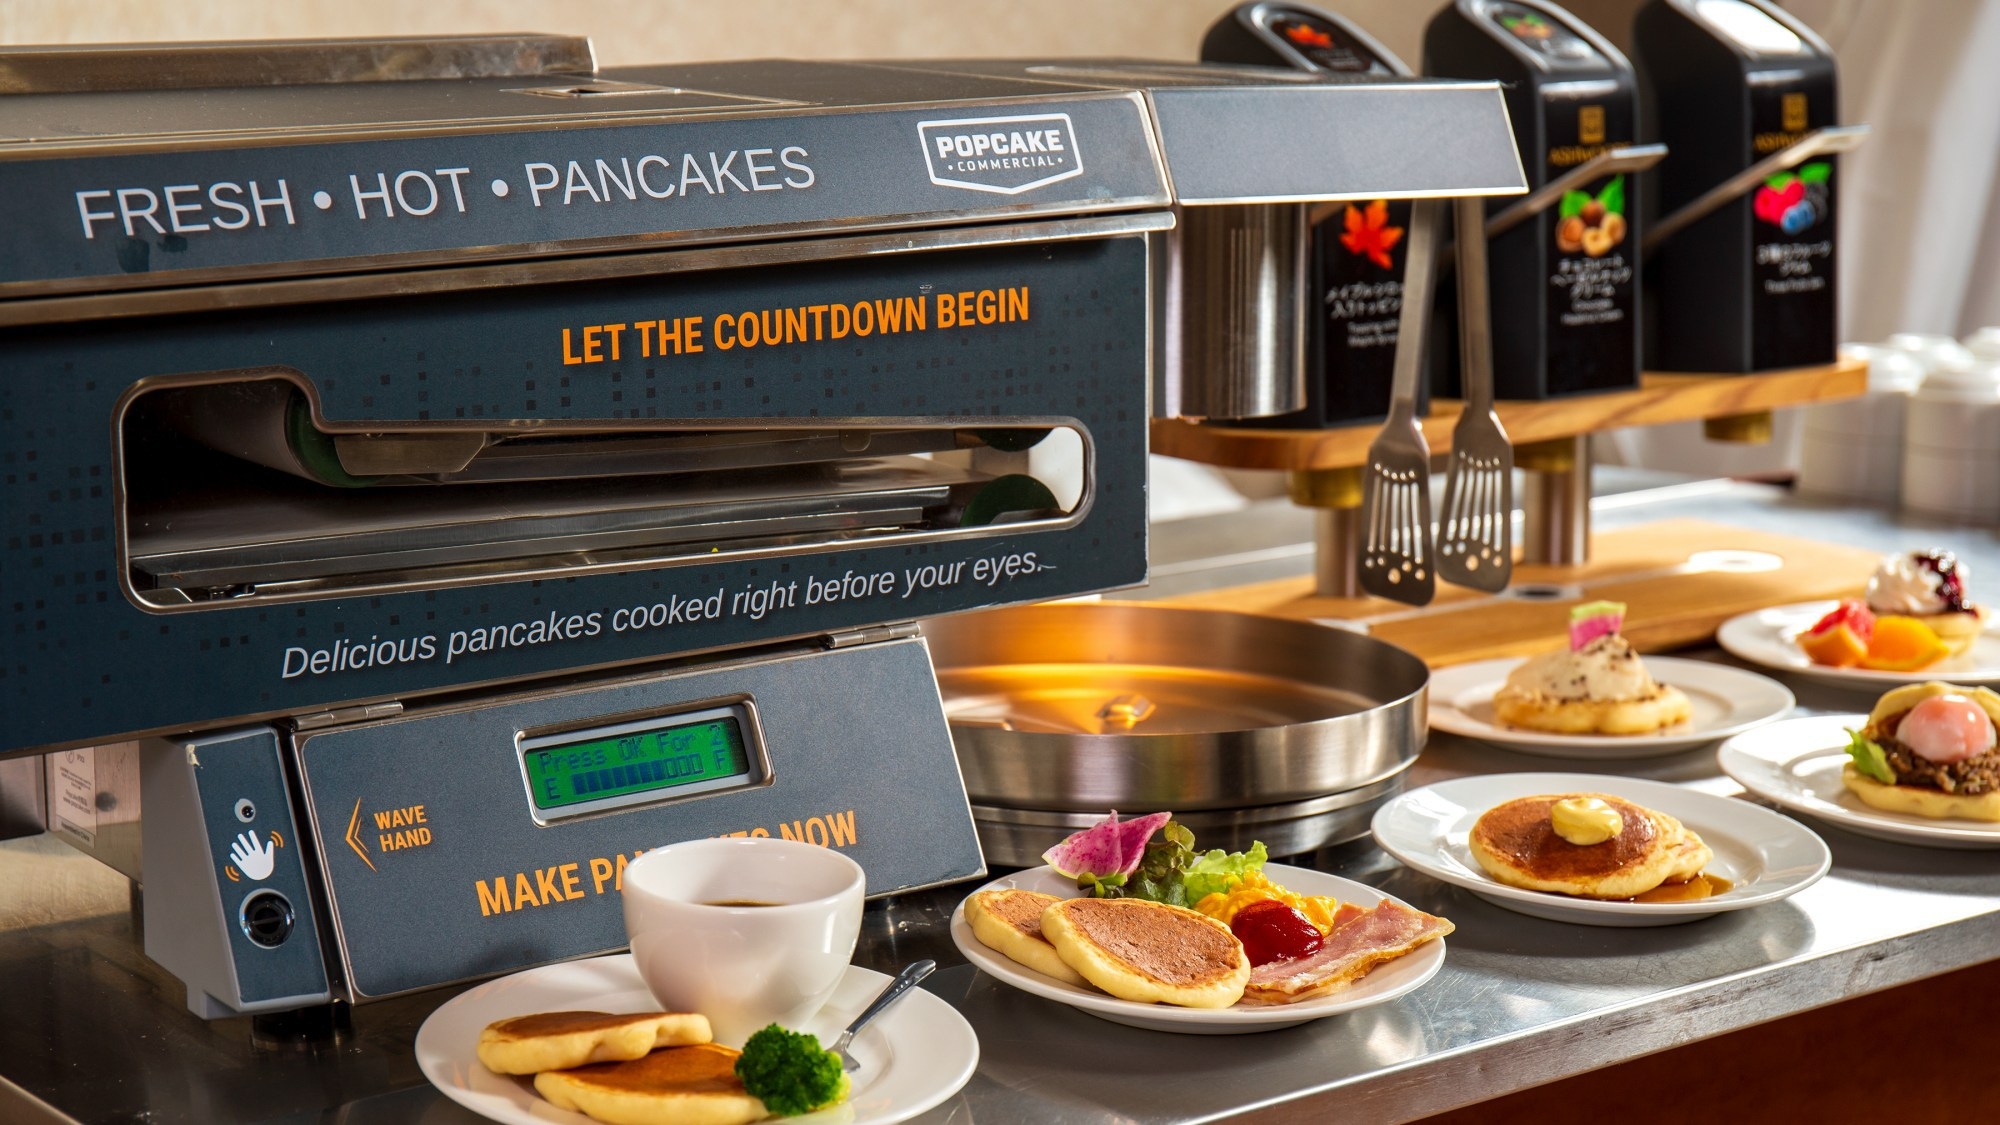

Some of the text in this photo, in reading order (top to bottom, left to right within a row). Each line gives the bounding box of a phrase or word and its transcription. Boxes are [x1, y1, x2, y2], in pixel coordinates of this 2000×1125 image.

[936, 129, 1064, 159] POPCAKE
[957, 154, 1055, 172] COMMERCIAL
[76, 146, 815, 239] FRESH HOT PANCAKES
[562, 286, 1029, 365] LET THE COUNTDOWN BEGIN
[283, 552, 1042, 680] Delicious pancakes cooked right before your eyes.
[538, 750, 608, 775] Press
[617, 737, 645, 761] OK
[657, 732, 696, 754] For
[544, 749, 727, 801] E F
[374, 805, 428, 830] WAVE
[380, 827, 432, 852] HAND
[475, 862, 586, 917] MAKE
